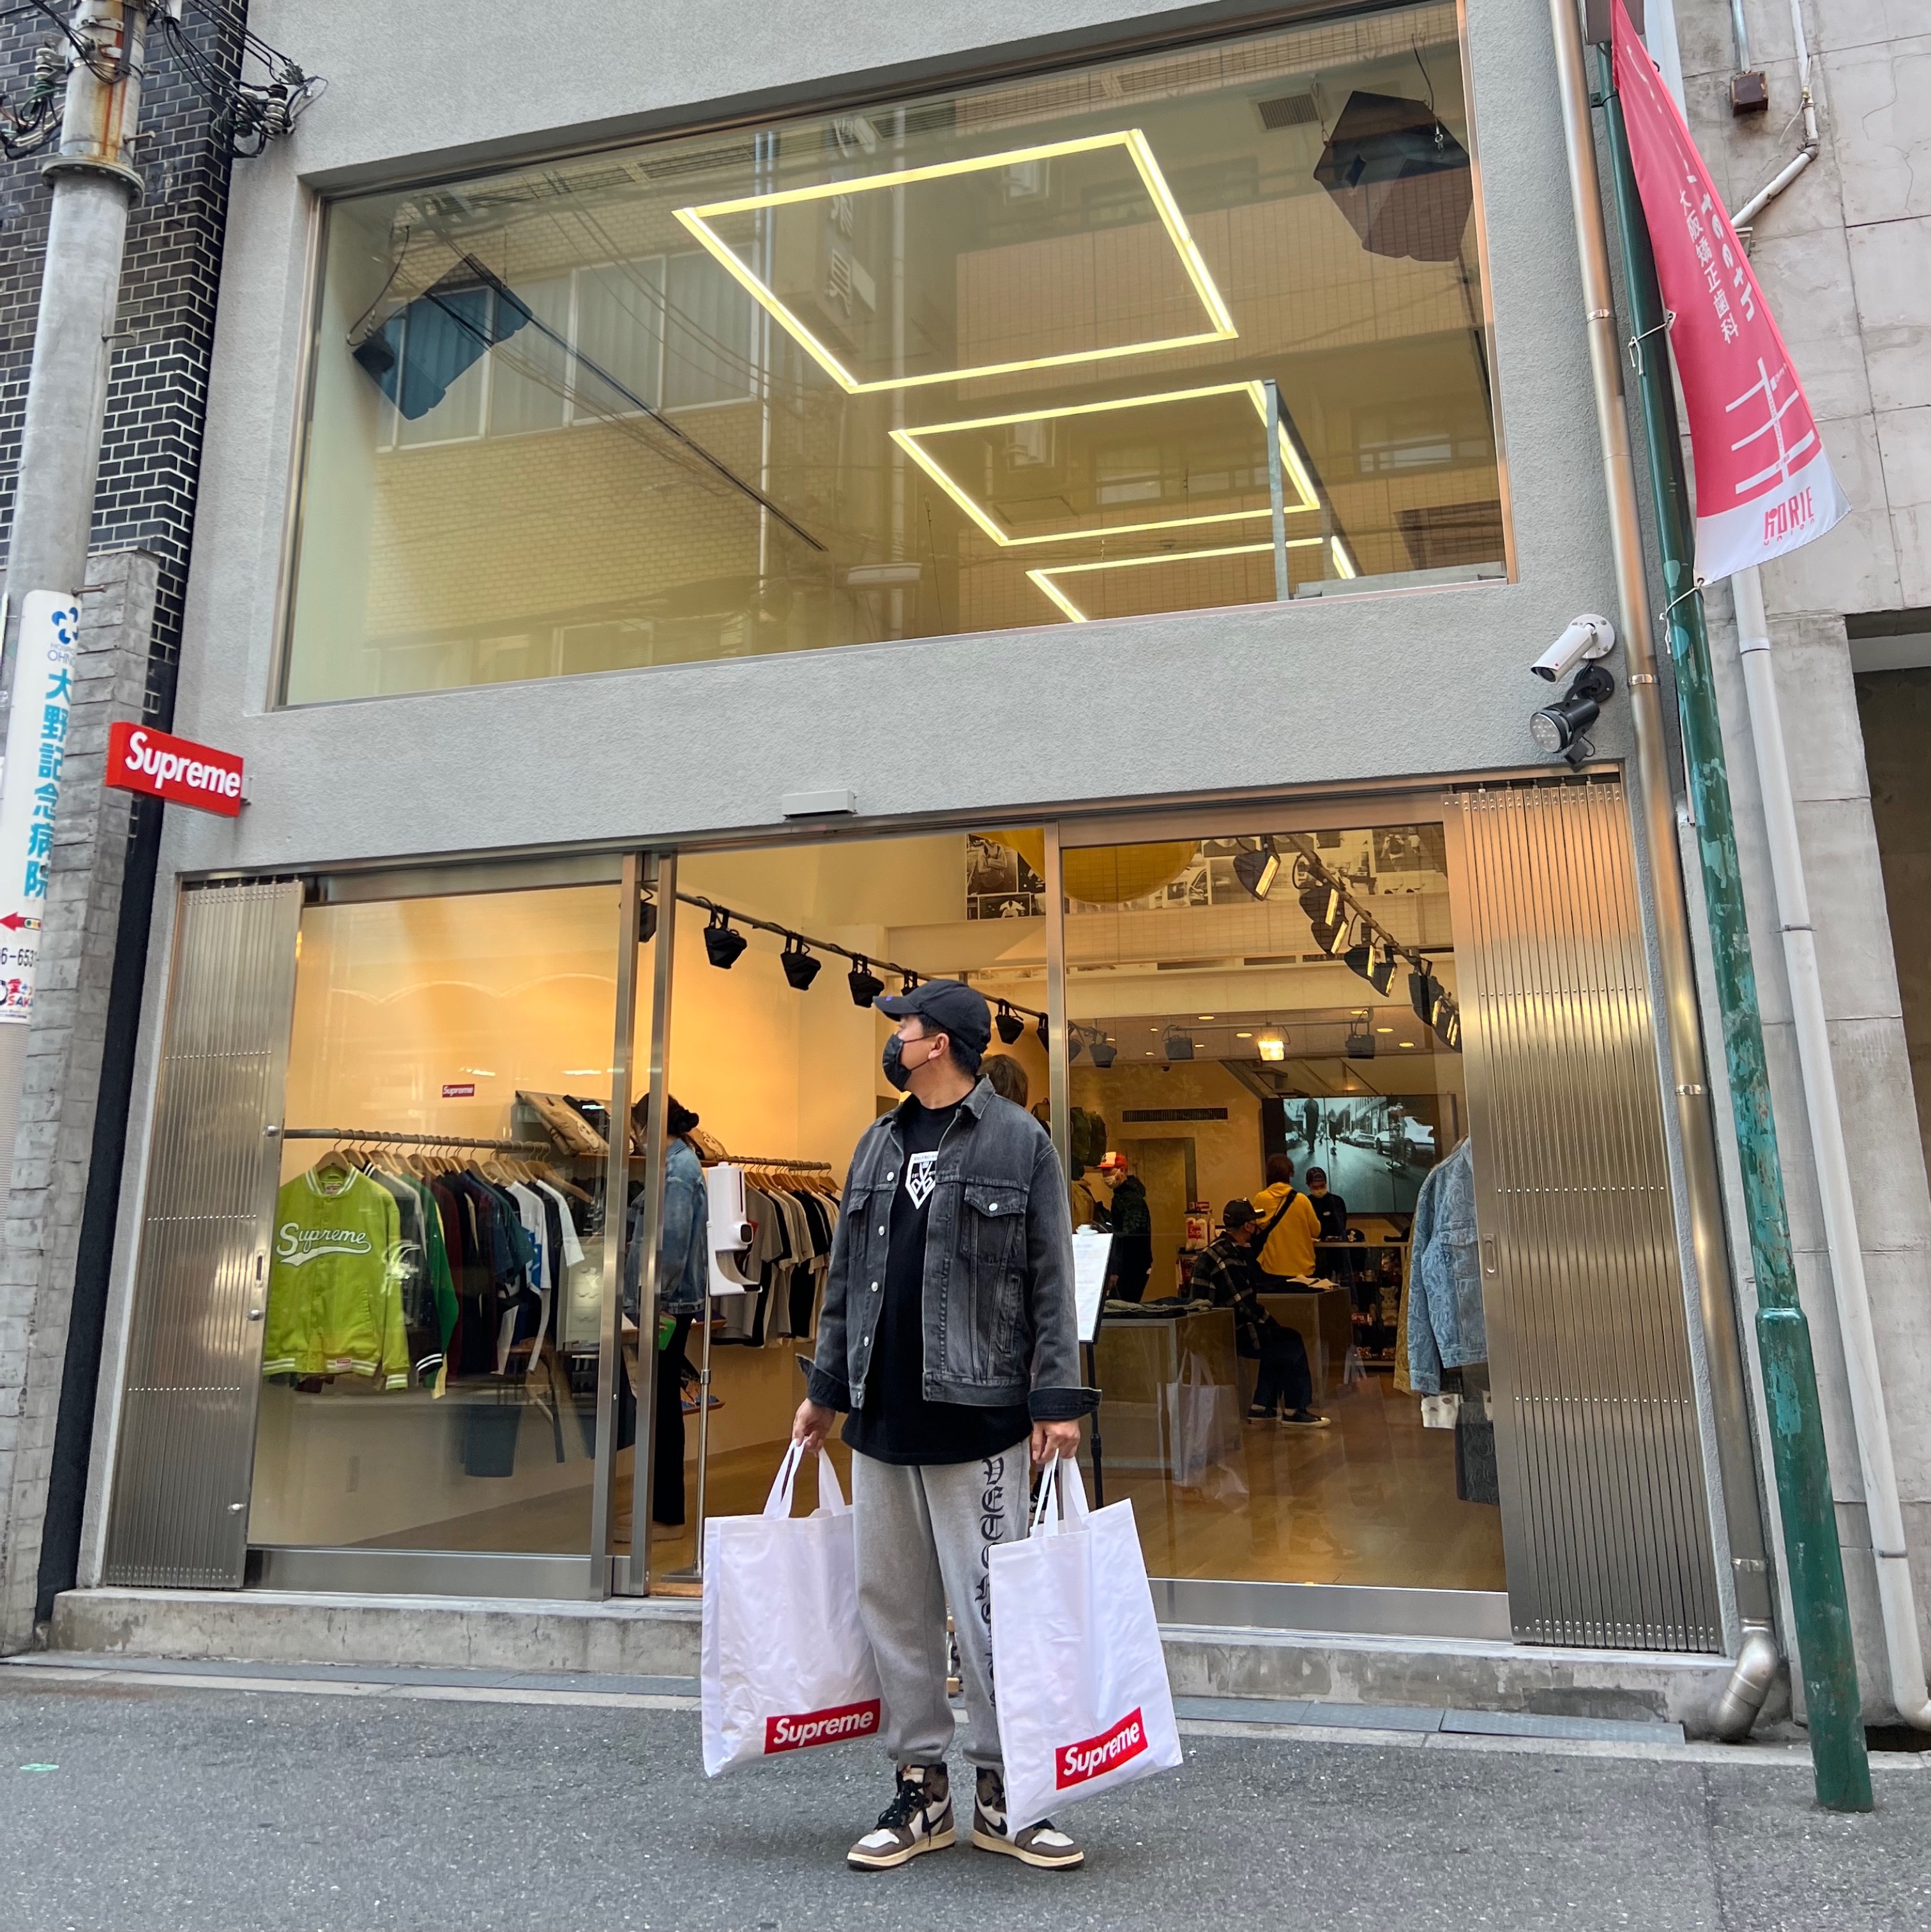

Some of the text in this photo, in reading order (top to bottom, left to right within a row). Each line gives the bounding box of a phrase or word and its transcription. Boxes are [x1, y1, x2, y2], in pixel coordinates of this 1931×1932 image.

[1679, 189, 1739, 344] 大阪矯正歯科
[24, 668, 72, 901] 大野記念病院
[125, 731, 241, 798] Supreme
[443, 1086, 474, 1097] Supreme
[276, 1222, 367, 1256] Supreme
[773, 1711, 874, 1747] Supreme
[1063, 1722, 1140, 1777] Supreme
